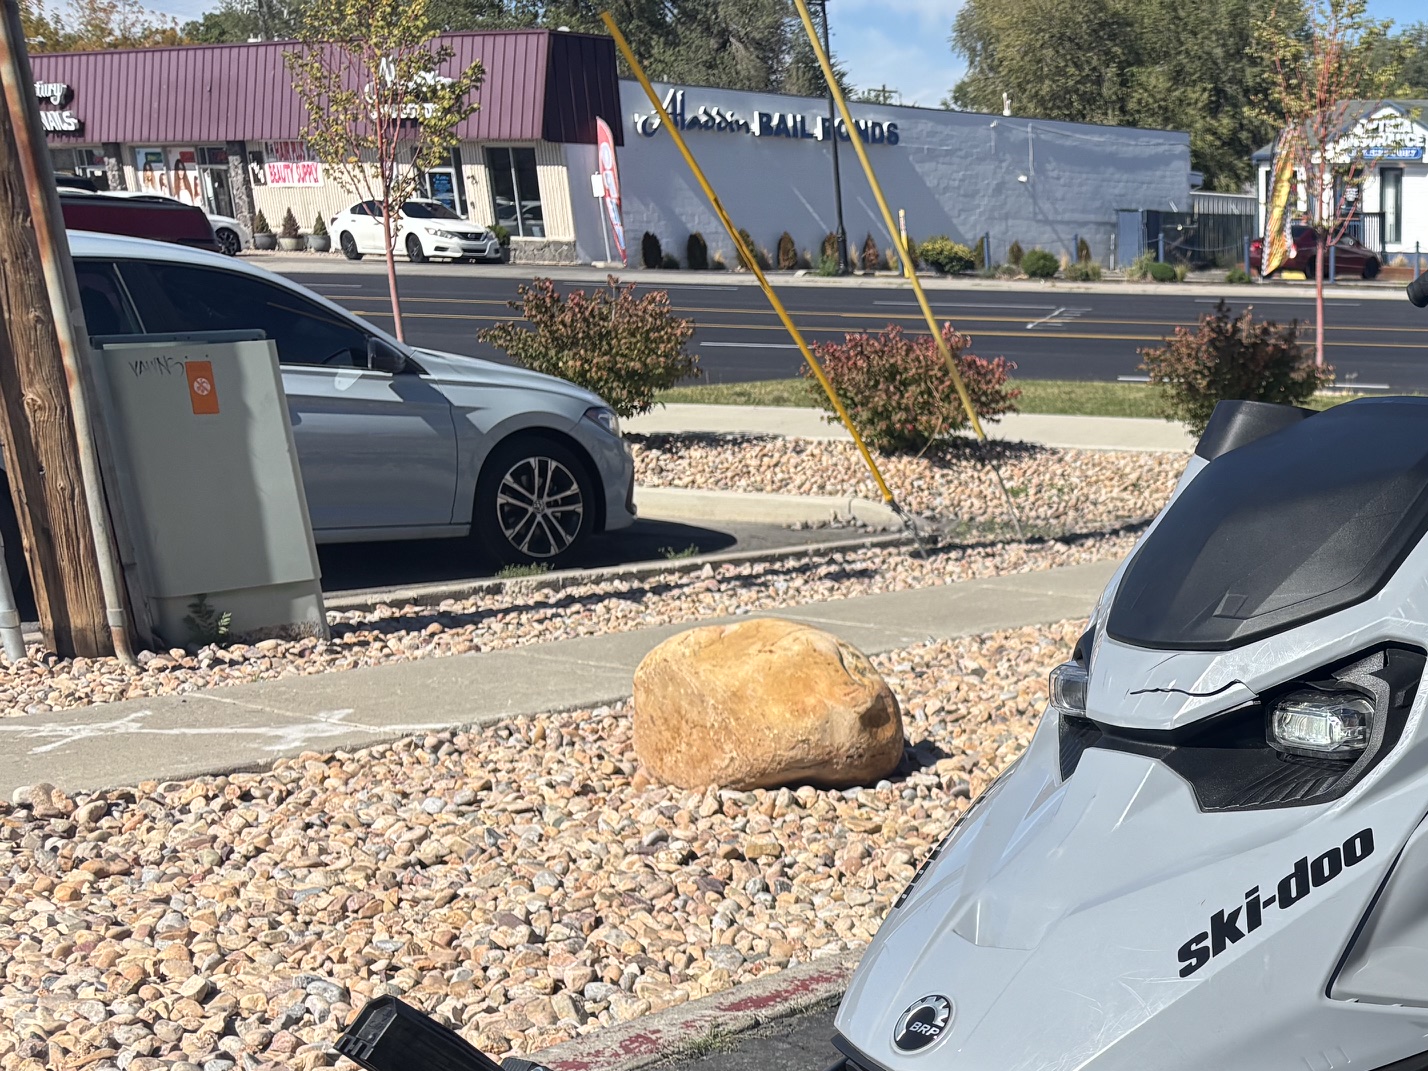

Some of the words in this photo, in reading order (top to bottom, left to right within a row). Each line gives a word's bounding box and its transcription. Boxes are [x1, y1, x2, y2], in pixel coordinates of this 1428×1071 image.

[40, 110, 79, 130] NAILS
[633, 89, 751, 138] Aladdin
[750, 110, 815, 139] BAIL
[813, 115, 899, 146] BONDS
[1177, 827, 1375, 978] ski-doo
[909, 1021, 940, 1036] BRP
